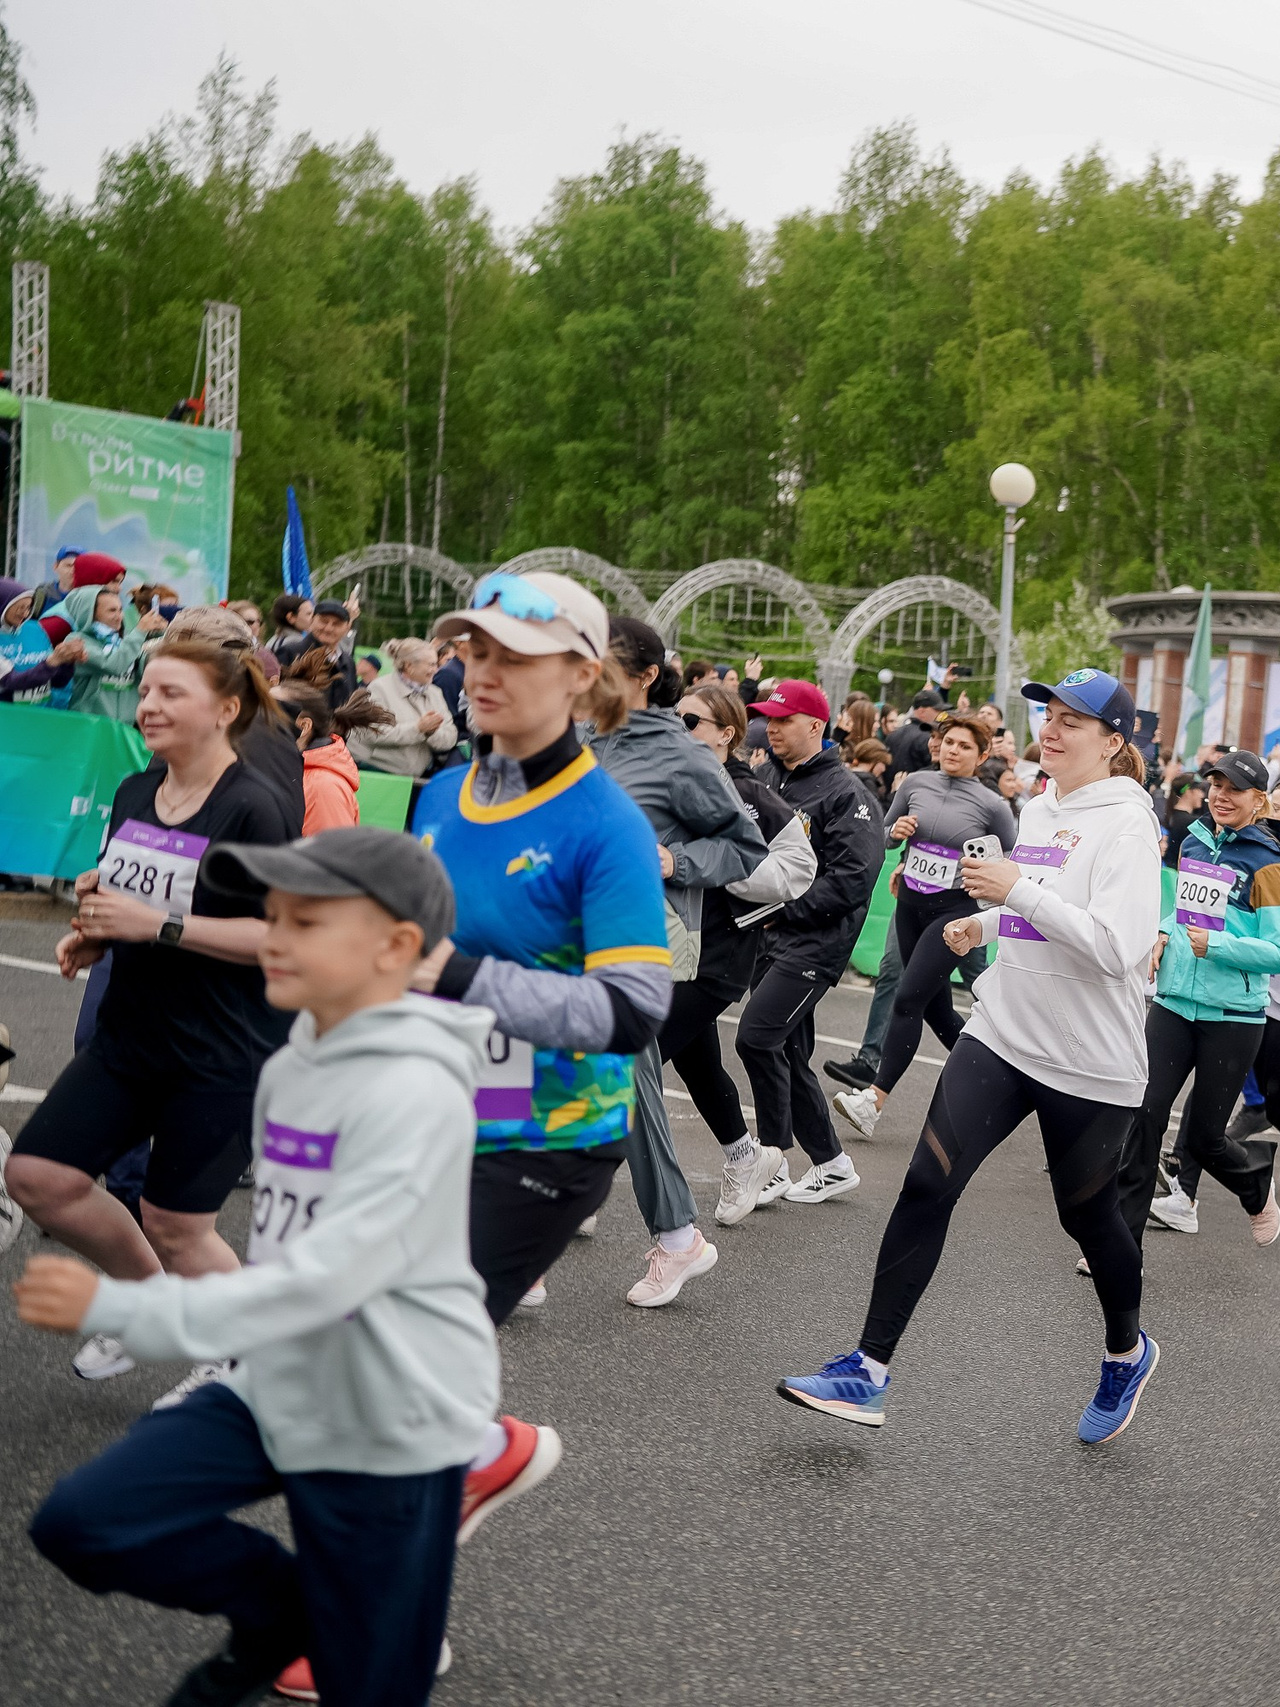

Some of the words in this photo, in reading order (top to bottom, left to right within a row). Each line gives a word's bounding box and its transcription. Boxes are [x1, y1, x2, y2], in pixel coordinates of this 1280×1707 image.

[109, 857, 175, 901] 2281
[911, 856, 948, 880] 2061
[1180, 881, 1220, 907] 2009
